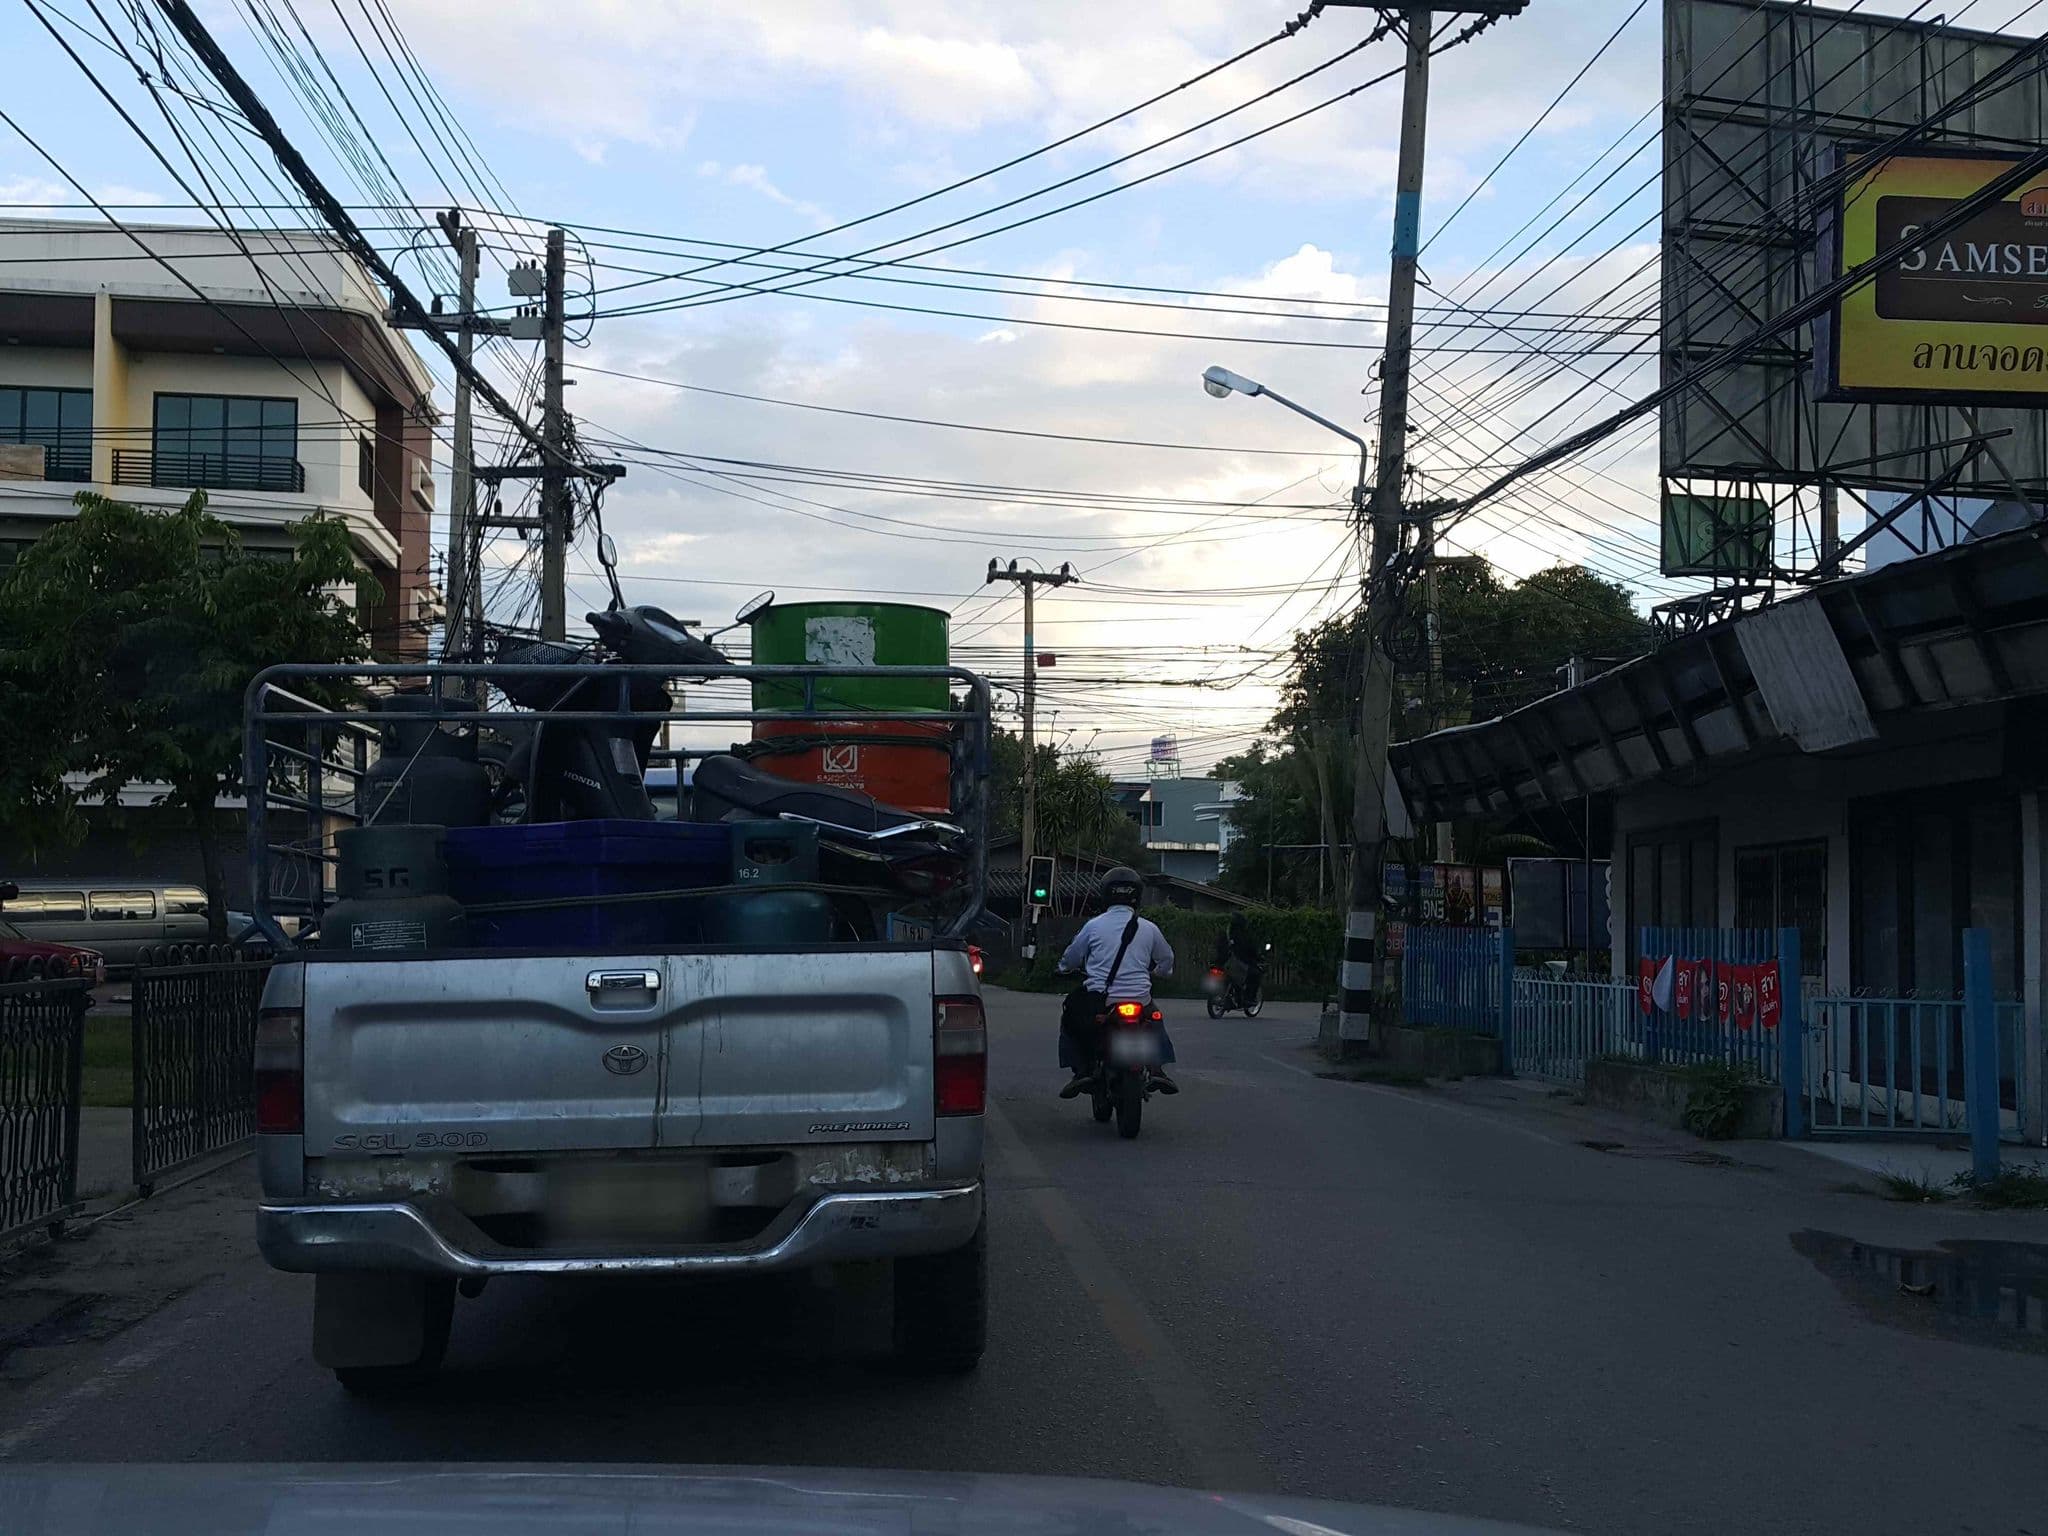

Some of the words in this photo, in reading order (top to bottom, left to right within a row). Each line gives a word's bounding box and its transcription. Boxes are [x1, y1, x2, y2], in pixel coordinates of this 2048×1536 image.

[1912, 342, 2048, 373] ลานจอด
[562, 769, 602, 791] HONDA
[738, 867, 760, 879] 16.2
